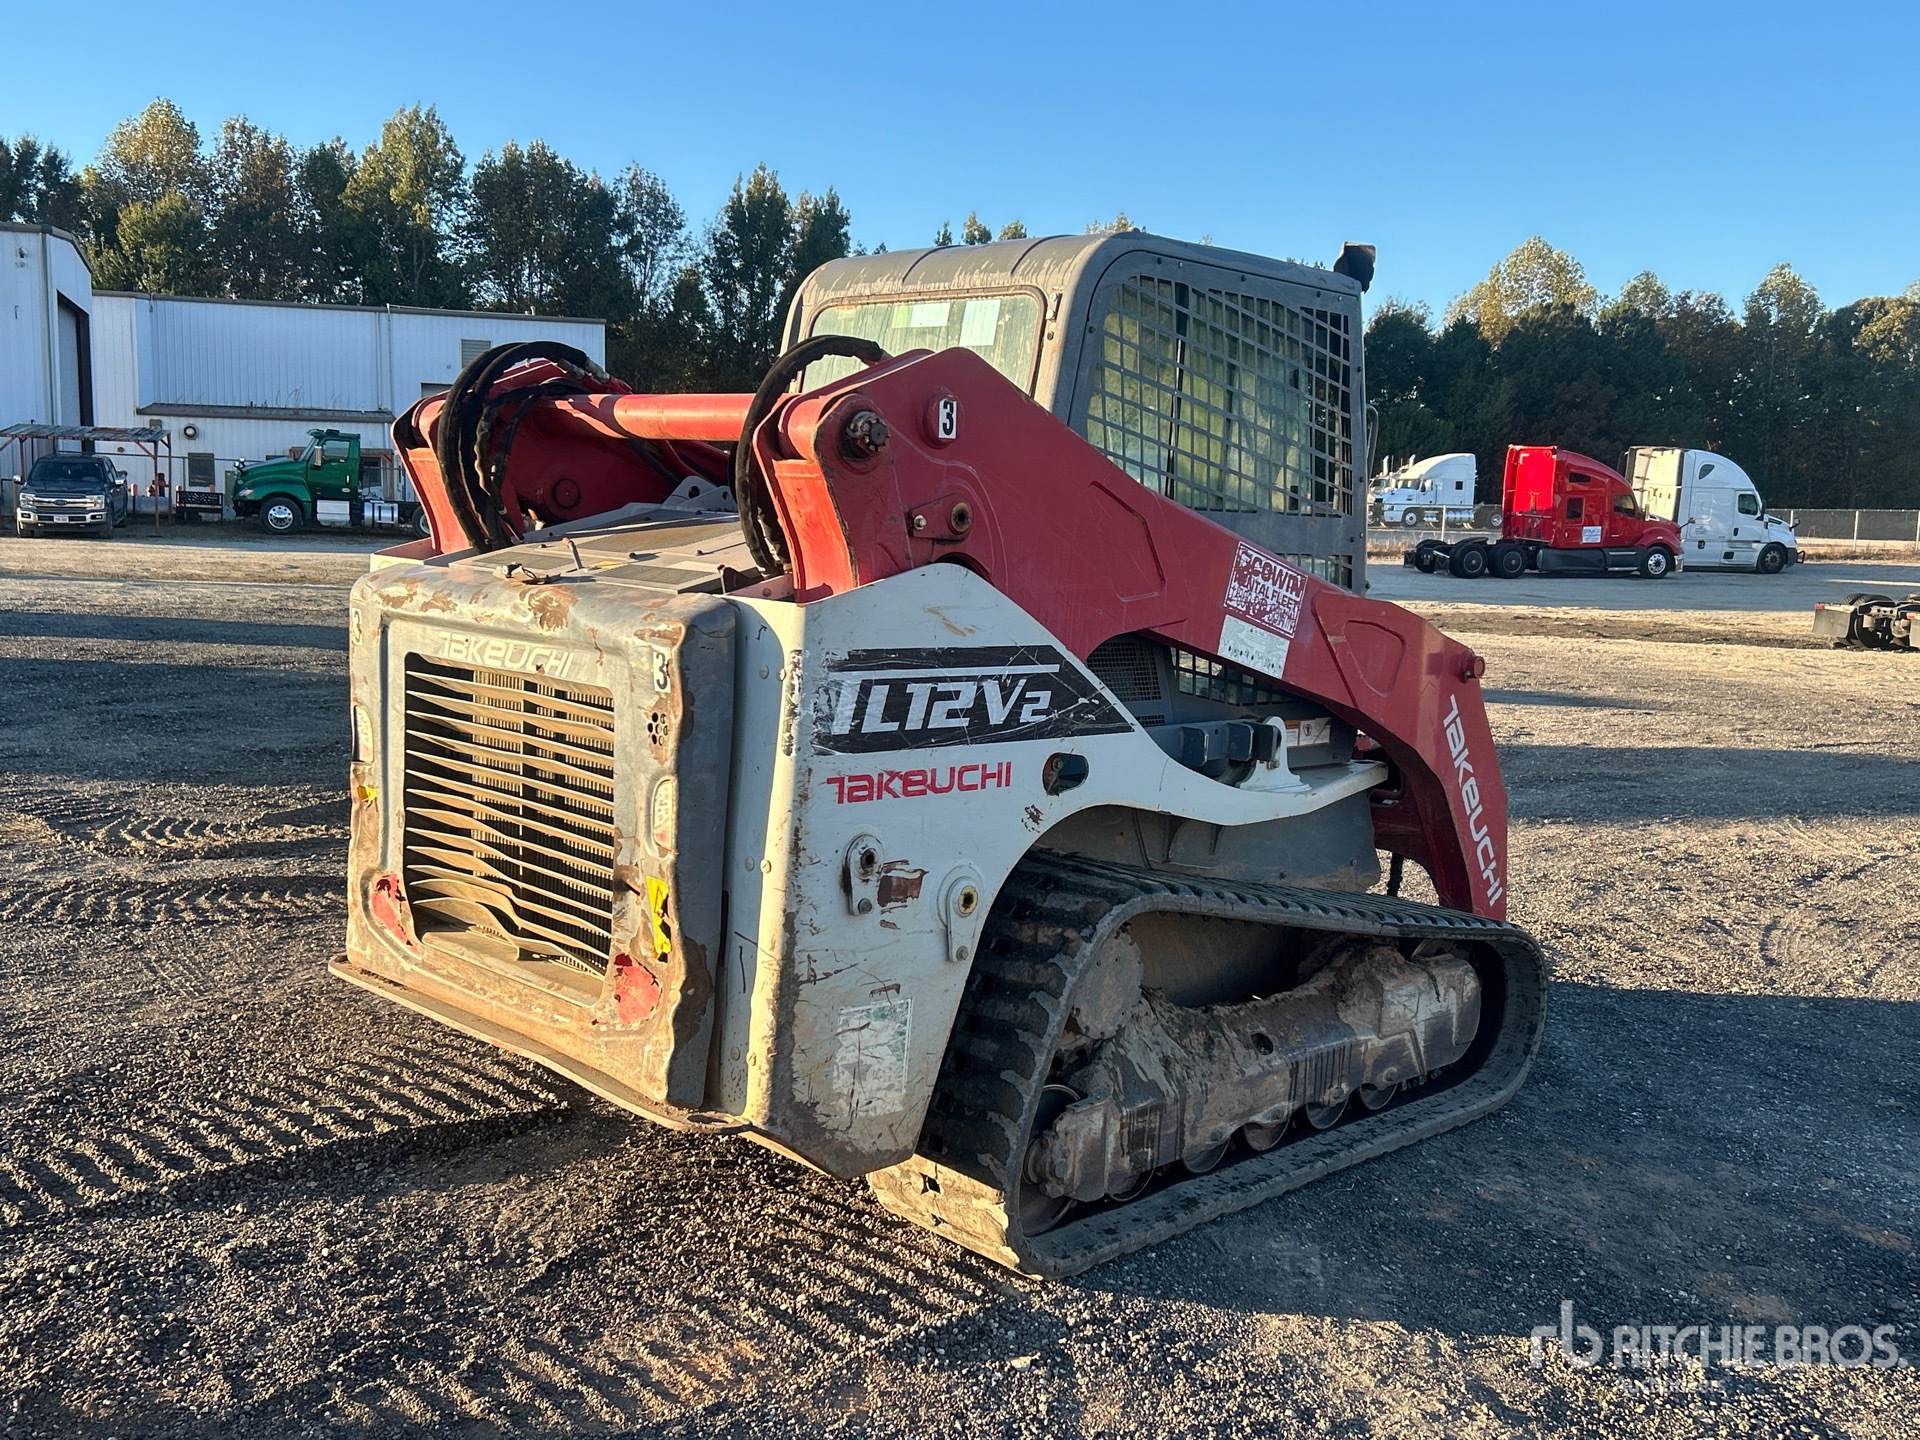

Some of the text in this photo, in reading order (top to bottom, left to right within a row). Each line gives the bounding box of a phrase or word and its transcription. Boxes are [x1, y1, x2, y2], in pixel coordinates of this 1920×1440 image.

[942, 399, 955, 436] 3
[654, 650, 670, 691] 3
[826, 761, 1012, 804] TAKEUCHI
[1443, 693, 1503, 907] TAKEUCHI
